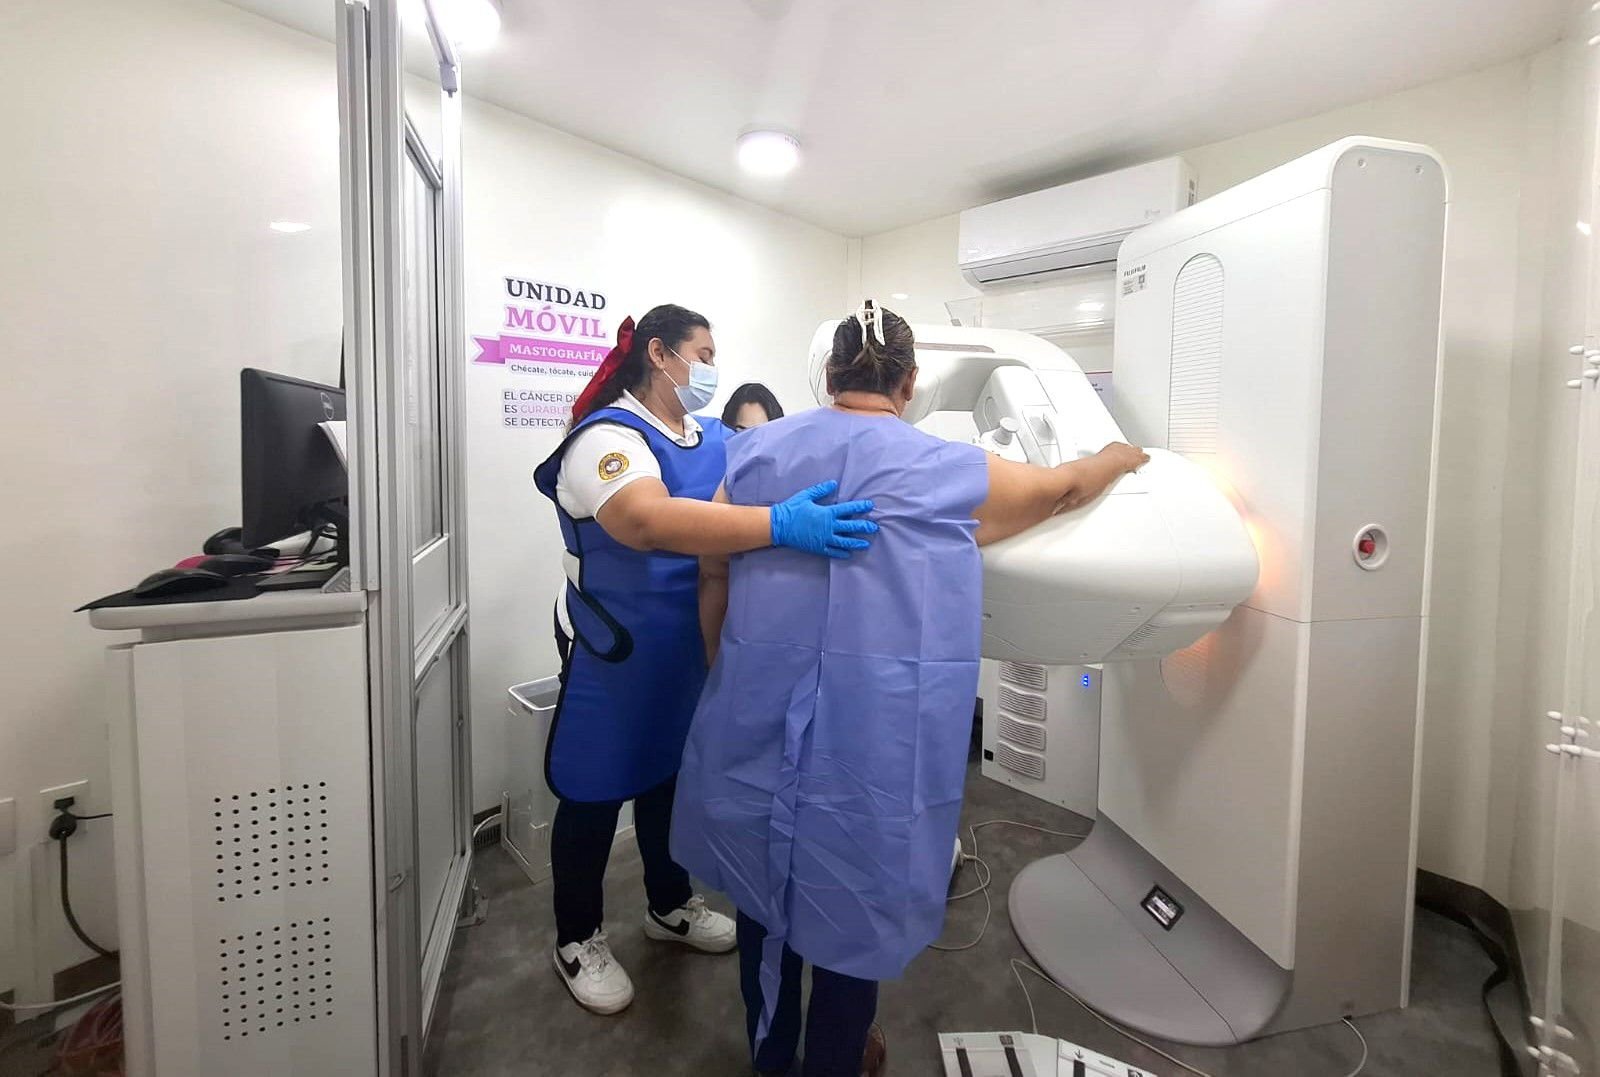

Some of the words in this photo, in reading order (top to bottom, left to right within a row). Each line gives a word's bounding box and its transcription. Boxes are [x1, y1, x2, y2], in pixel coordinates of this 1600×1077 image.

[505, 277, 606, 310] UNIDAD
[506, 305, 606, 339] MÓVIL
[509, 343, 603, 362] MASTOGRAFÍA
[511, 364, 547, 375] Chécate,
[549, 367, 576, 377] tócate,
[504, 391, 517, 401] EL
[504, 404, 518, 414] ES
[520, 405, 568, 415] CURABLE
[504, 417, 518, 427] SE
[520, 418, 566, 427] DETECTA
